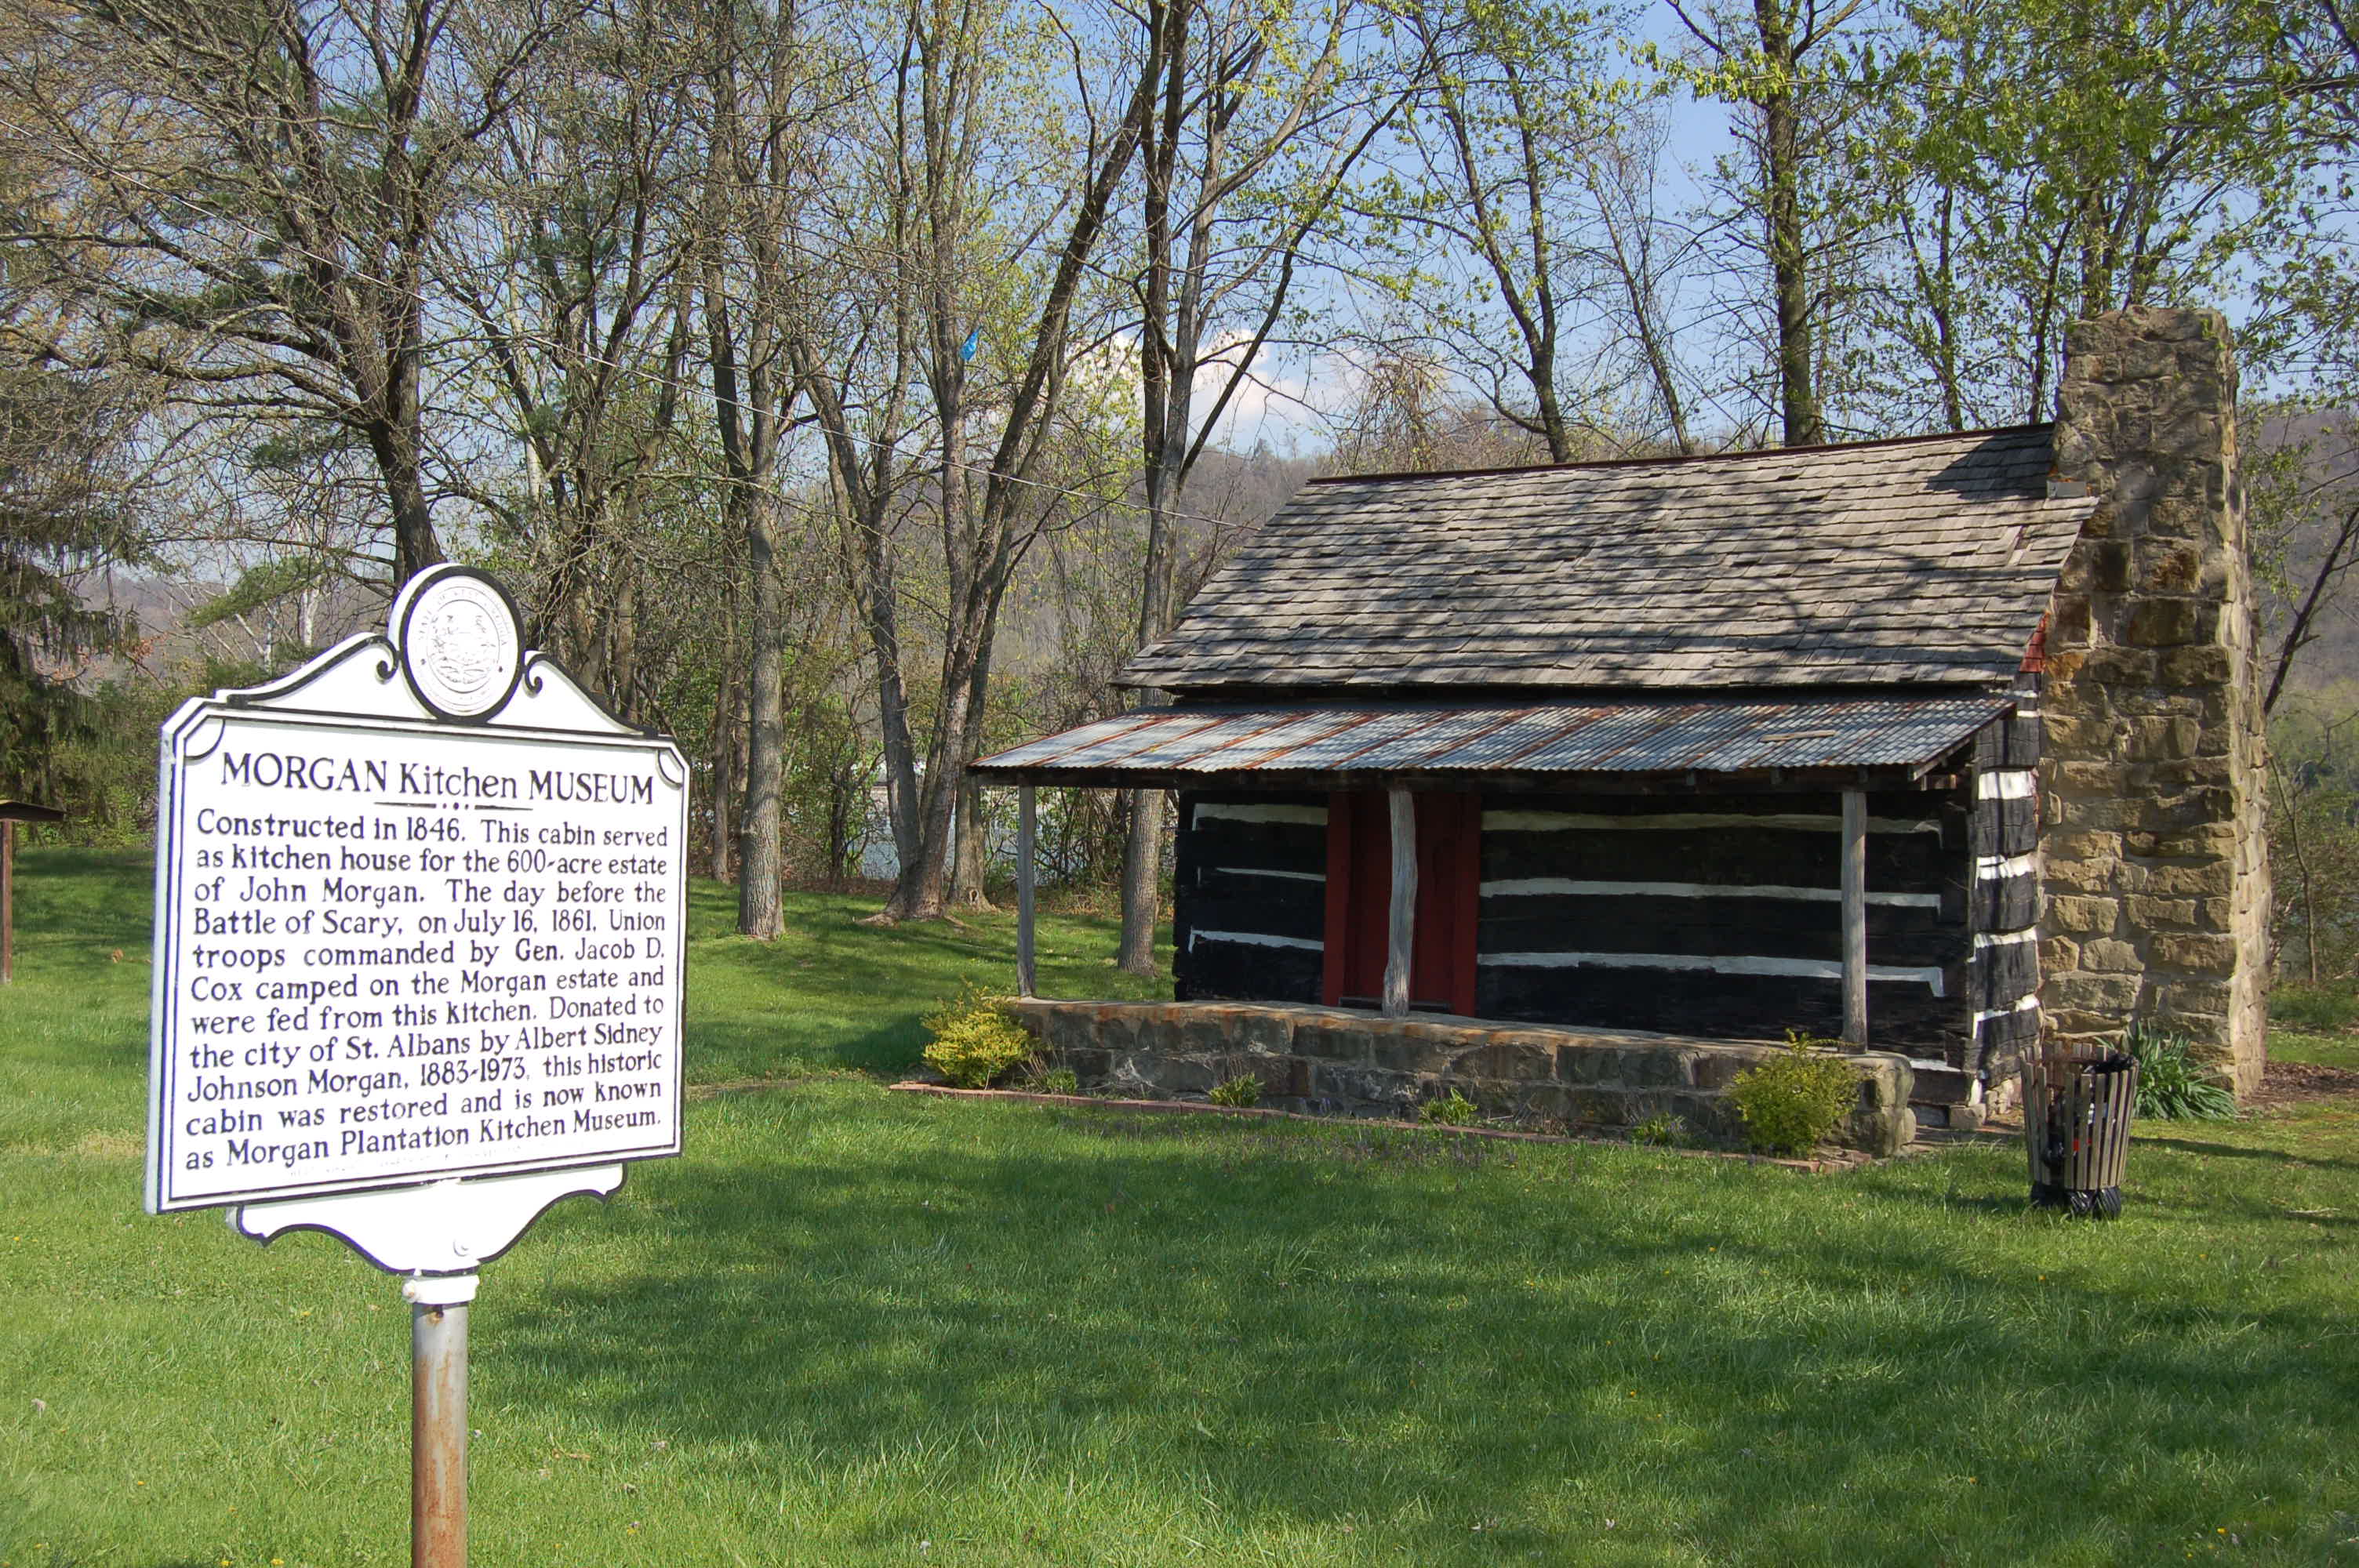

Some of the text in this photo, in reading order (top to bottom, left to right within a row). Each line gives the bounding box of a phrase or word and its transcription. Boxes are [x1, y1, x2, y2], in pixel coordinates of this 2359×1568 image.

[221, 752, 653, 805] MORGAN Kitchen MUSEUM
[197, 808, 667, 847] Constructed in 1846. This cabin served
[197, 849, 224, 868] as
[340, 845, 411, 871] house
[419, 848, 455, 872] for
[463, 849, 500, 873] the
[507, 848, 602, 874] 600-acre
[608, 856, 667, 876] estate
[194, 876, 666, 909] of John Morgan. The day before the
[194, 907, 276, 935] Battle
[285, 909, 315, 934] of
[322, 909, 402, 938] Scary,
[418, 916, 446, 934] on
[453, 908, 506, 937] July
[609, 909, 665, 931] Union
[192, 937, 664, 974] troops commanded by Gen. Jacob D.
[191, 964, 663, 1005] Cox camped on the Morgan estate and
[191, 1015, 255, 1034] were
[267, 1006, 308, 1033] fed
[319, 1005, 383, 1030] from
[391, 1004, 437, 1026] this
[549, 993, 636, 1019] Donated
[644, 996, 663, 1014] to
[189, 1022, 663, 1069] the city of St. Albans by Albert Sidney
[187, 1075, 297, 1102] Johnson
[307, 1069, 409, 1098] Morgan,
[543, 1054, 582, 1077] this
[588, 1050, 662, 1074] historic
[186, 1081, 661, 1136] cabin was restored and is now known
[186, 1151, 213, 1171] as
[227, 1138, 329, 1168] Morgan
[340, 1127, 469, 1156] Plantation
[480, 1115, 565, 1142] Kitchen
[573, 1109, 661, 1133] Museum.
